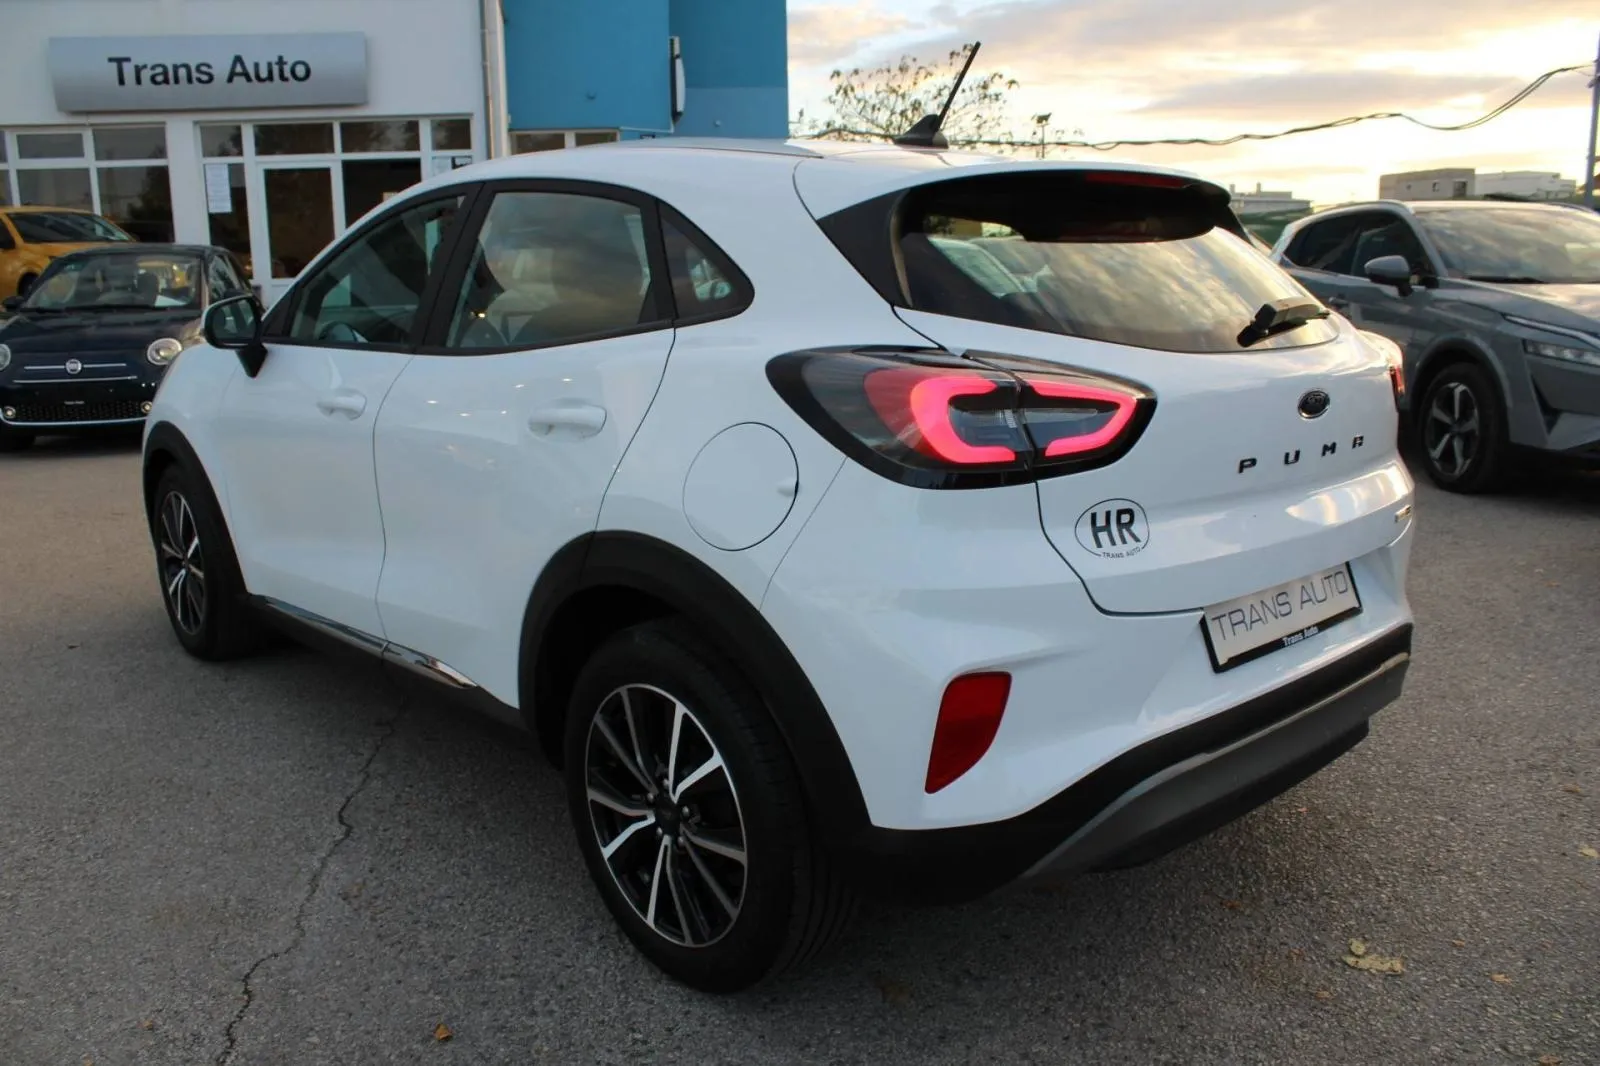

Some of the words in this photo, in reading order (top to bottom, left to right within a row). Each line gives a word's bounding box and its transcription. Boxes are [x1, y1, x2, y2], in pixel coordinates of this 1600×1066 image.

[107, 56, 215, 86] Trans
[226, 54, 312, 84] Auto
[1238, 435, 1364, 474] PUMA
[1091, 508, 1141, 548] HR
[1102, 551, 1125, 559] TRANS
[1211, 591, 1293, 640] TRANS
[1300, 570, 1349, 610] AUTO
